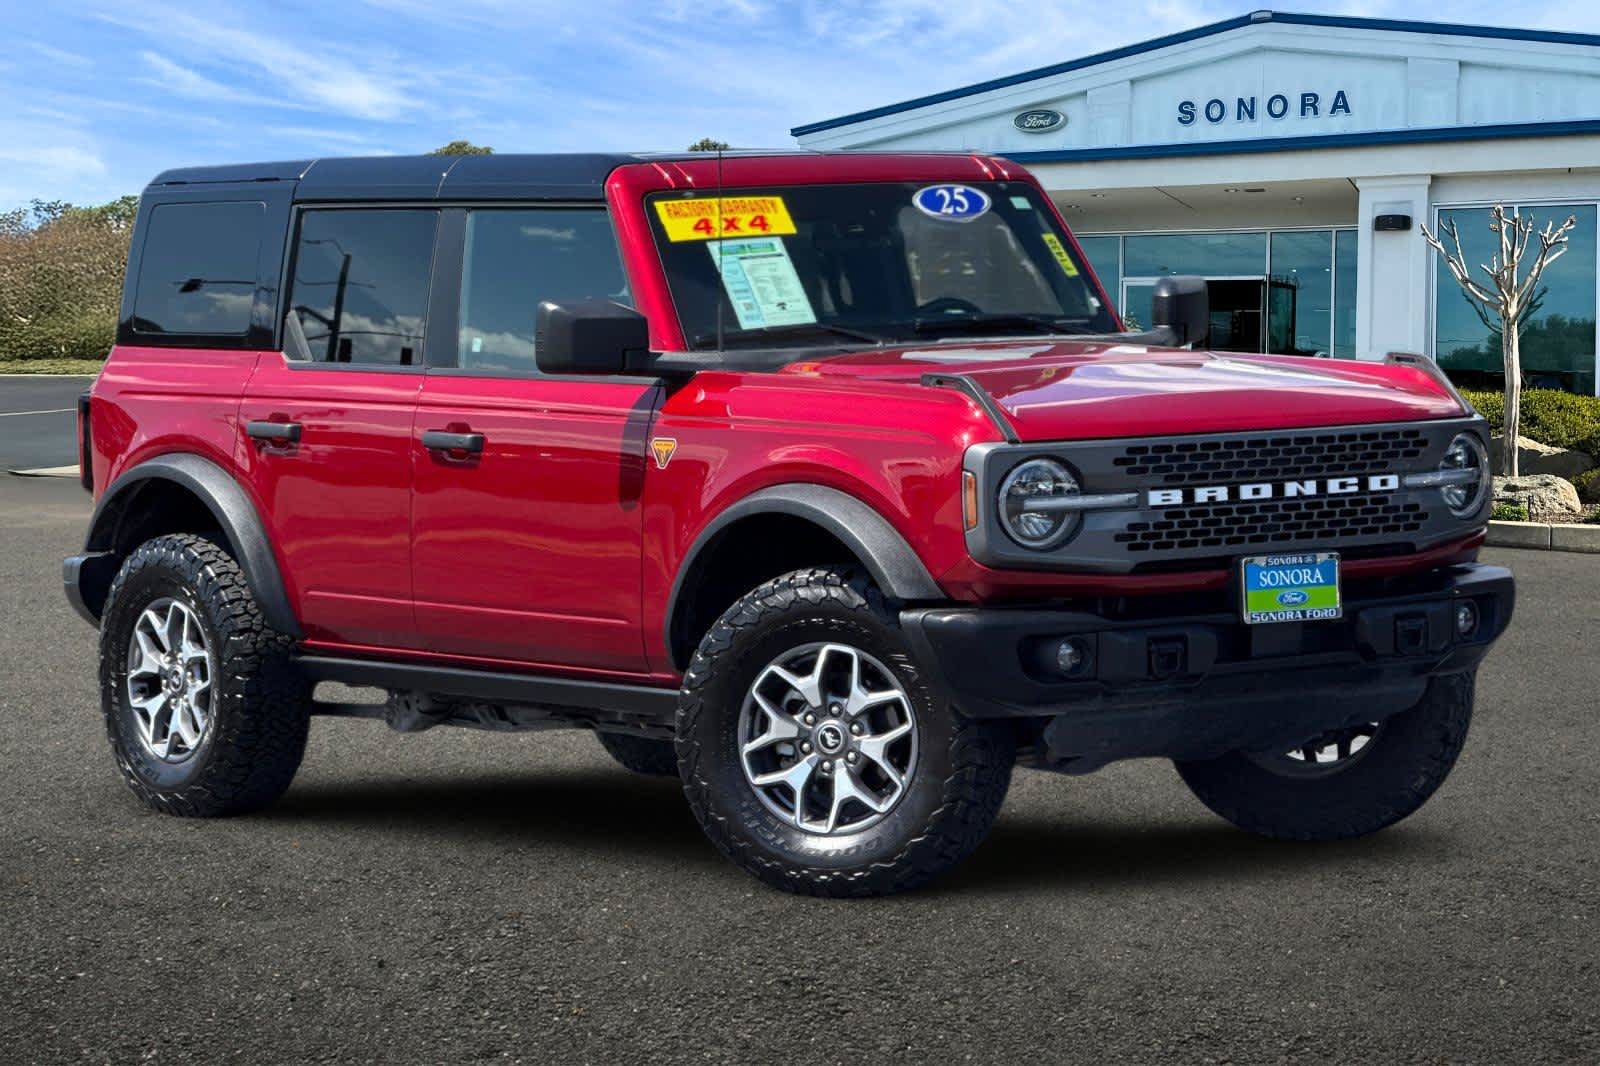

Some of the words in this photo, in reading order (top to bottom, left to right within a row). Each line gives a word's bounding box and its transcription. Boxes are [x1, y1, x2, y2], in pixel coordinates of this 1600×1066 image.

[1177, 90, 1351, 125] SONORA
[1023, 111, 1051, 128] Ford
[664, 201, 717, 219] FACTORY
[936, 188, 969, 214] 25
[1147, 473, 1399, 507] BRONCO
[1267, 556, 1303, 566] SONORA
[1259, 568, 1324, 587] SONORA
[1282, 592, 1304, 604] Ford
[1252, 611, 1303, 622] SONORA
[1306, 608, 1337, 619] FORD
